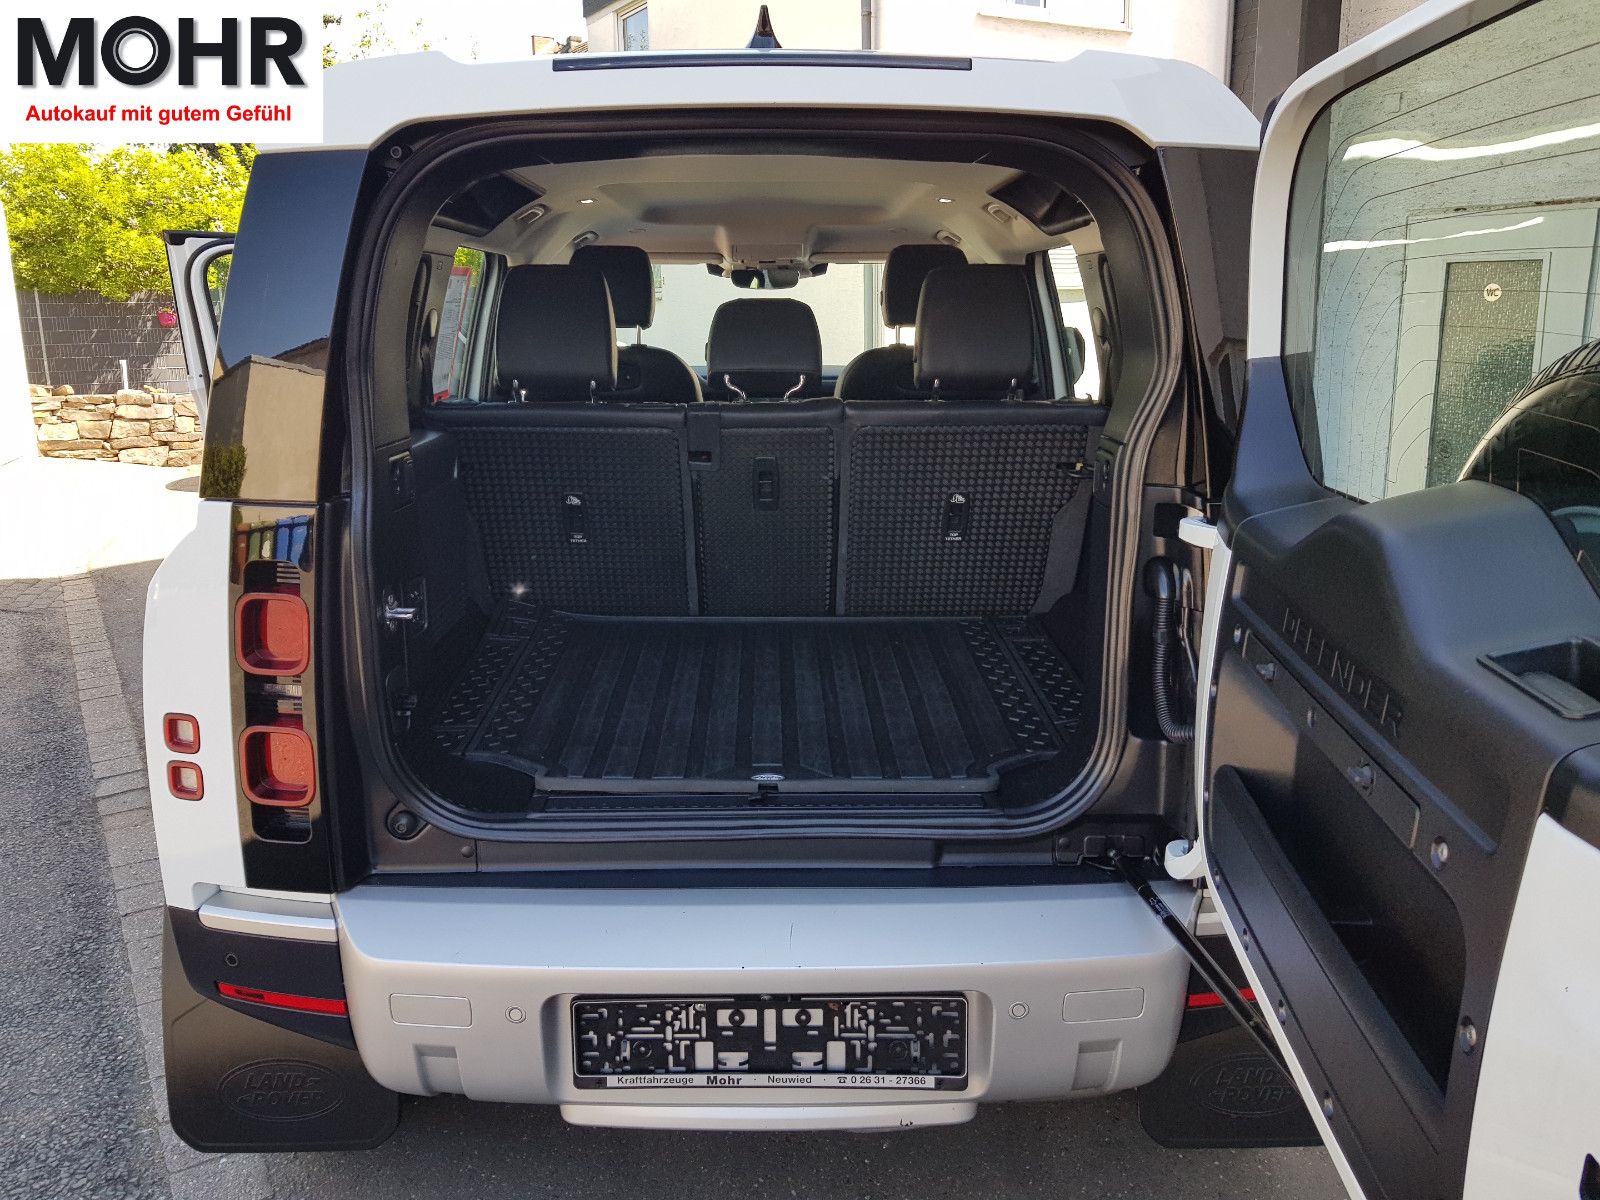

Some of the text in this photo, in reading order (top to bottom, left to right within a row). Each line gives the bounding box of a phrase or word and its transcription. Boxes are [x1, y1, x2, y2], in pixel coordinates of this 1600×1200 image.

[1486, 288, 1499, 297] WC
[617, 1075, 694, 1086] Kraftfahrzeuge
[706, 1075, 742, 1085] Mohr
[767, 1075, 812, 1084] Neuwied
[895, 1075, 926, 1086] 27366
